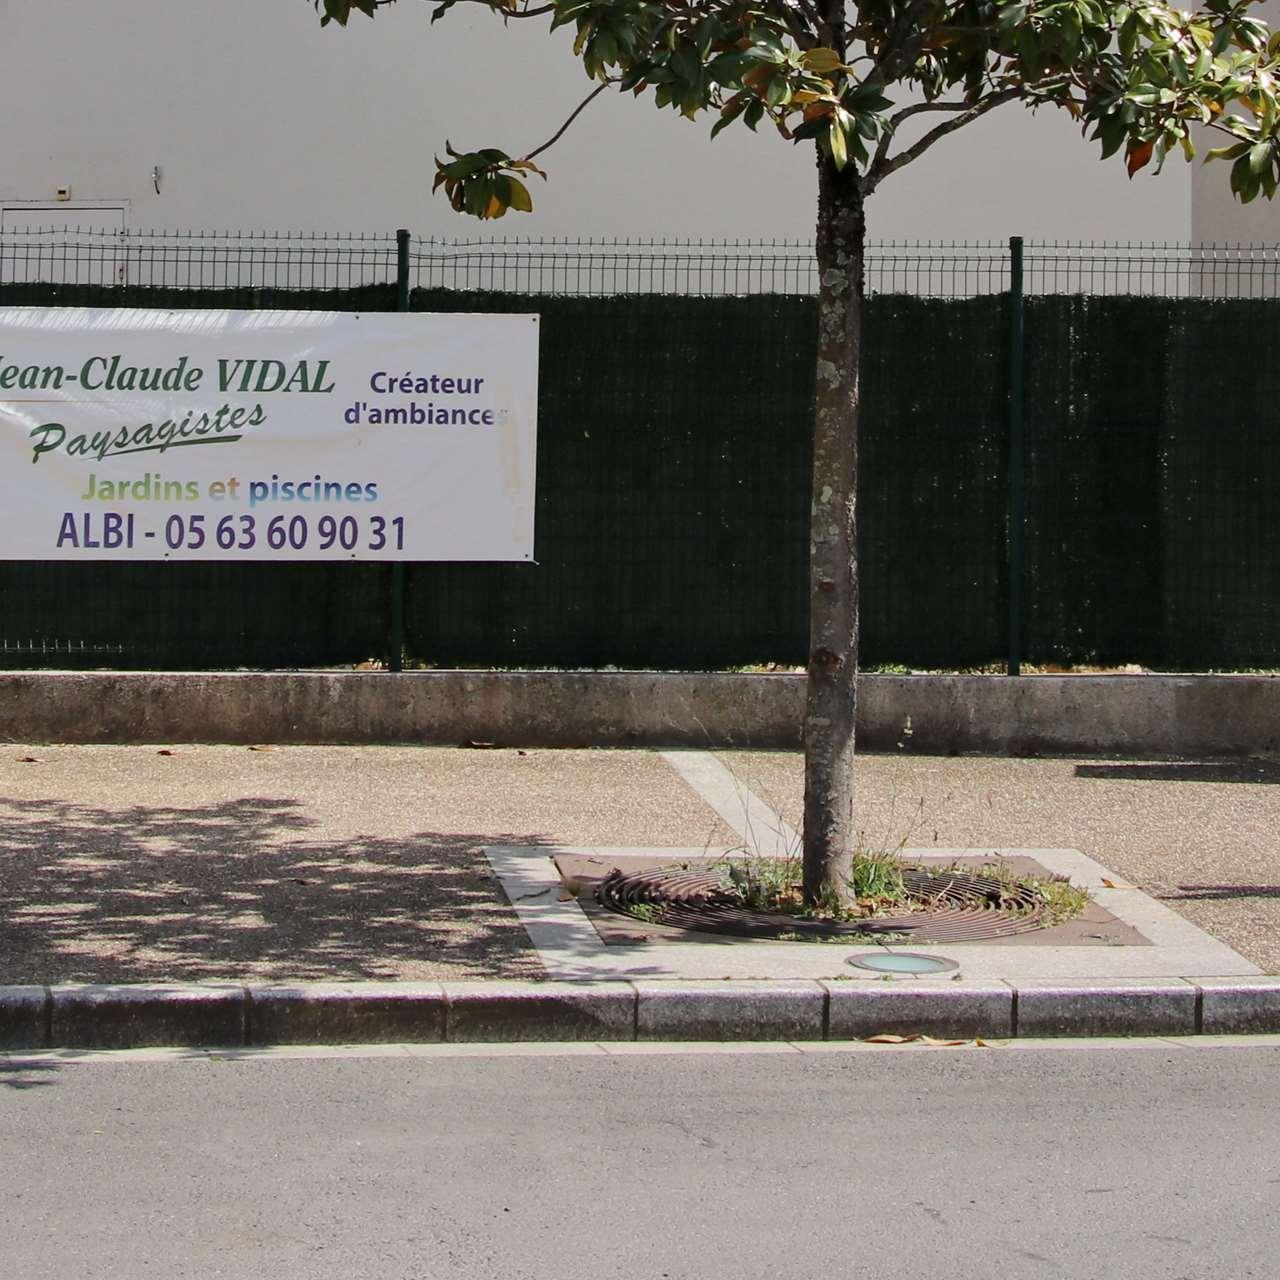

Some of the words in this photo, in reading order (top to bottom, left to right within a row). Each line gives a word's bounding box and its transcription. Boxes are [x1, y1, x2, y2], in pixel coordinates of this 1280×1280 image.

[216, 359, 335, 393] VIDAL
[370, 371, 484, 394] Créateur
[344, 402, 510, 425] d'ambiance
[29, 403, 267, 464] Paysagistes
[81, 473, 200, 502] Jardins
[208, 475, 241, 501] et
[249, 474, 378, 508] piscines
[56, 513, 134, 548] ALBI
[165, 515, 205, 549] 05
[216, 515, 256, 549] 63
[267, 515, 308, 550] 60
[318, 516, 358, 550] 90
[370, 516, 405, 550] 31
